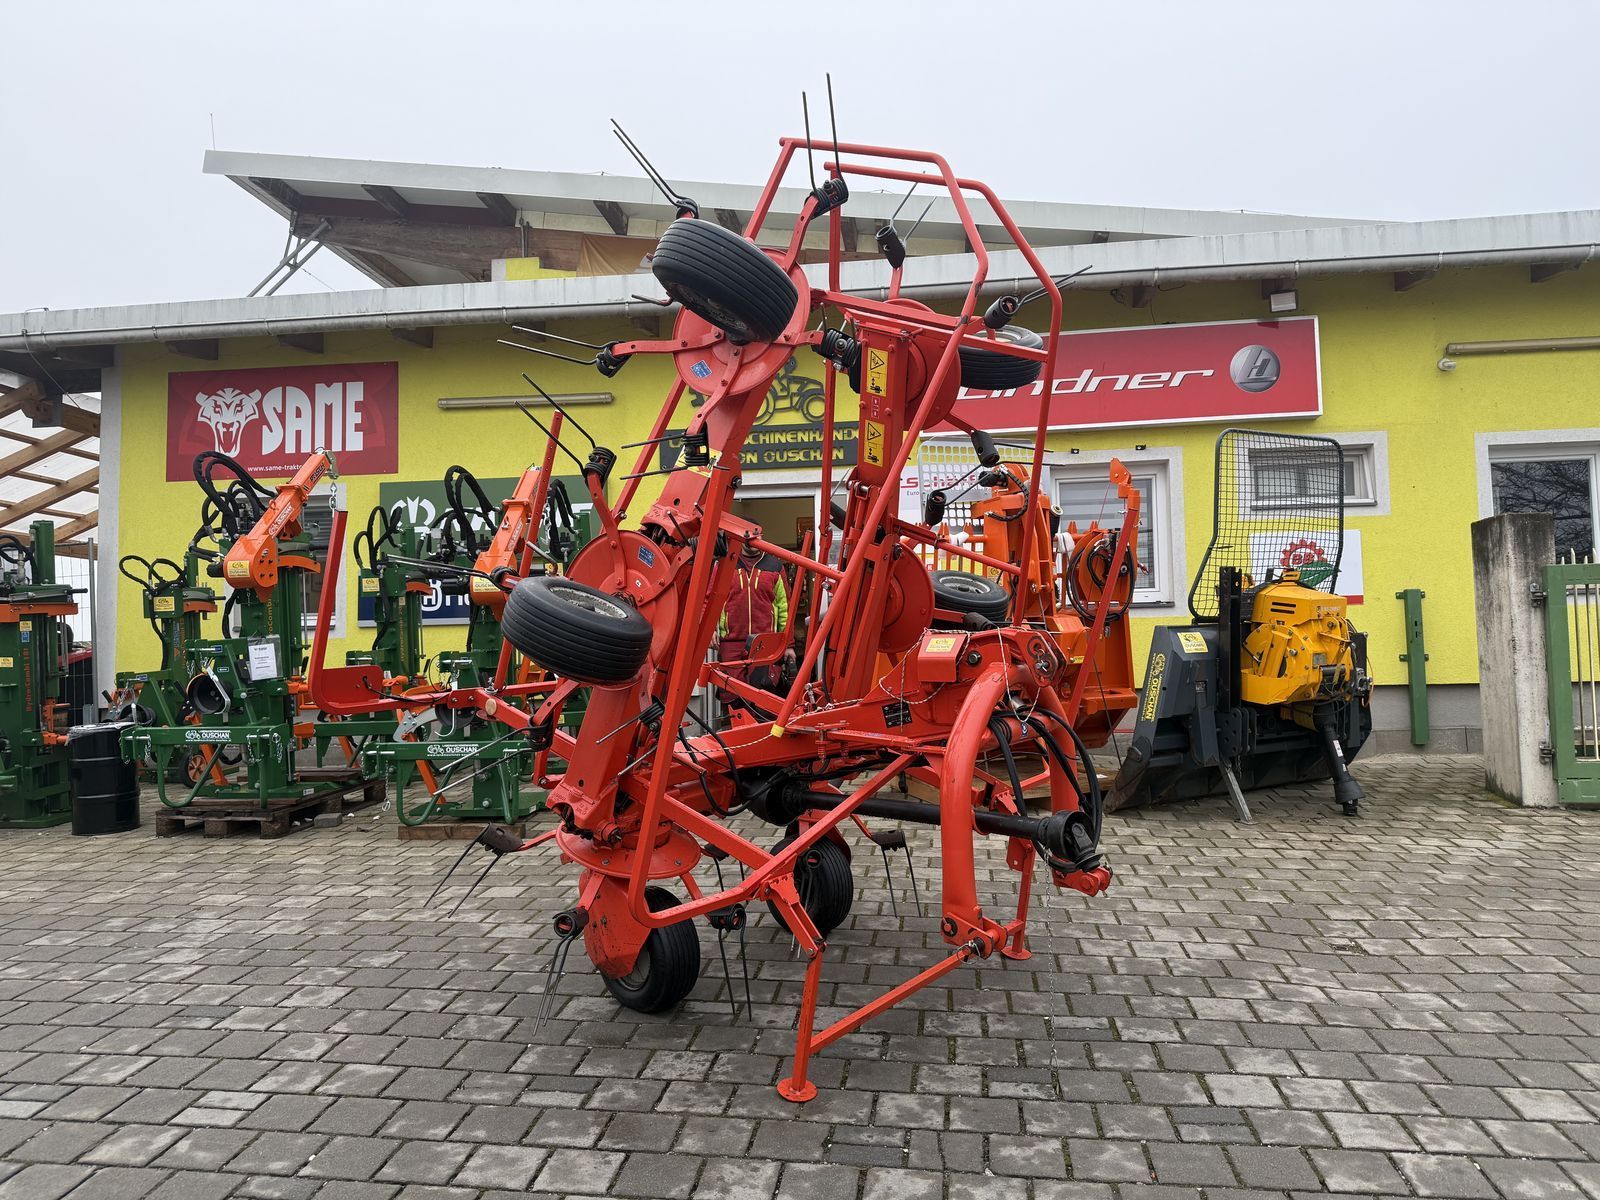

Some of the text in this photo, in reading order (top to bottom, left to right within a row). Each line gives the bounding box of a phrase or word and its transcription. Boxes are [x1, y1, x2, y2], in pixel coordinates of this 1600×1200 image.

[262, 381, 364, 455] SAME
[763, 446, 844, 463] OUSCHN
[1145, 678, 1158, 720] OUSCHAN
